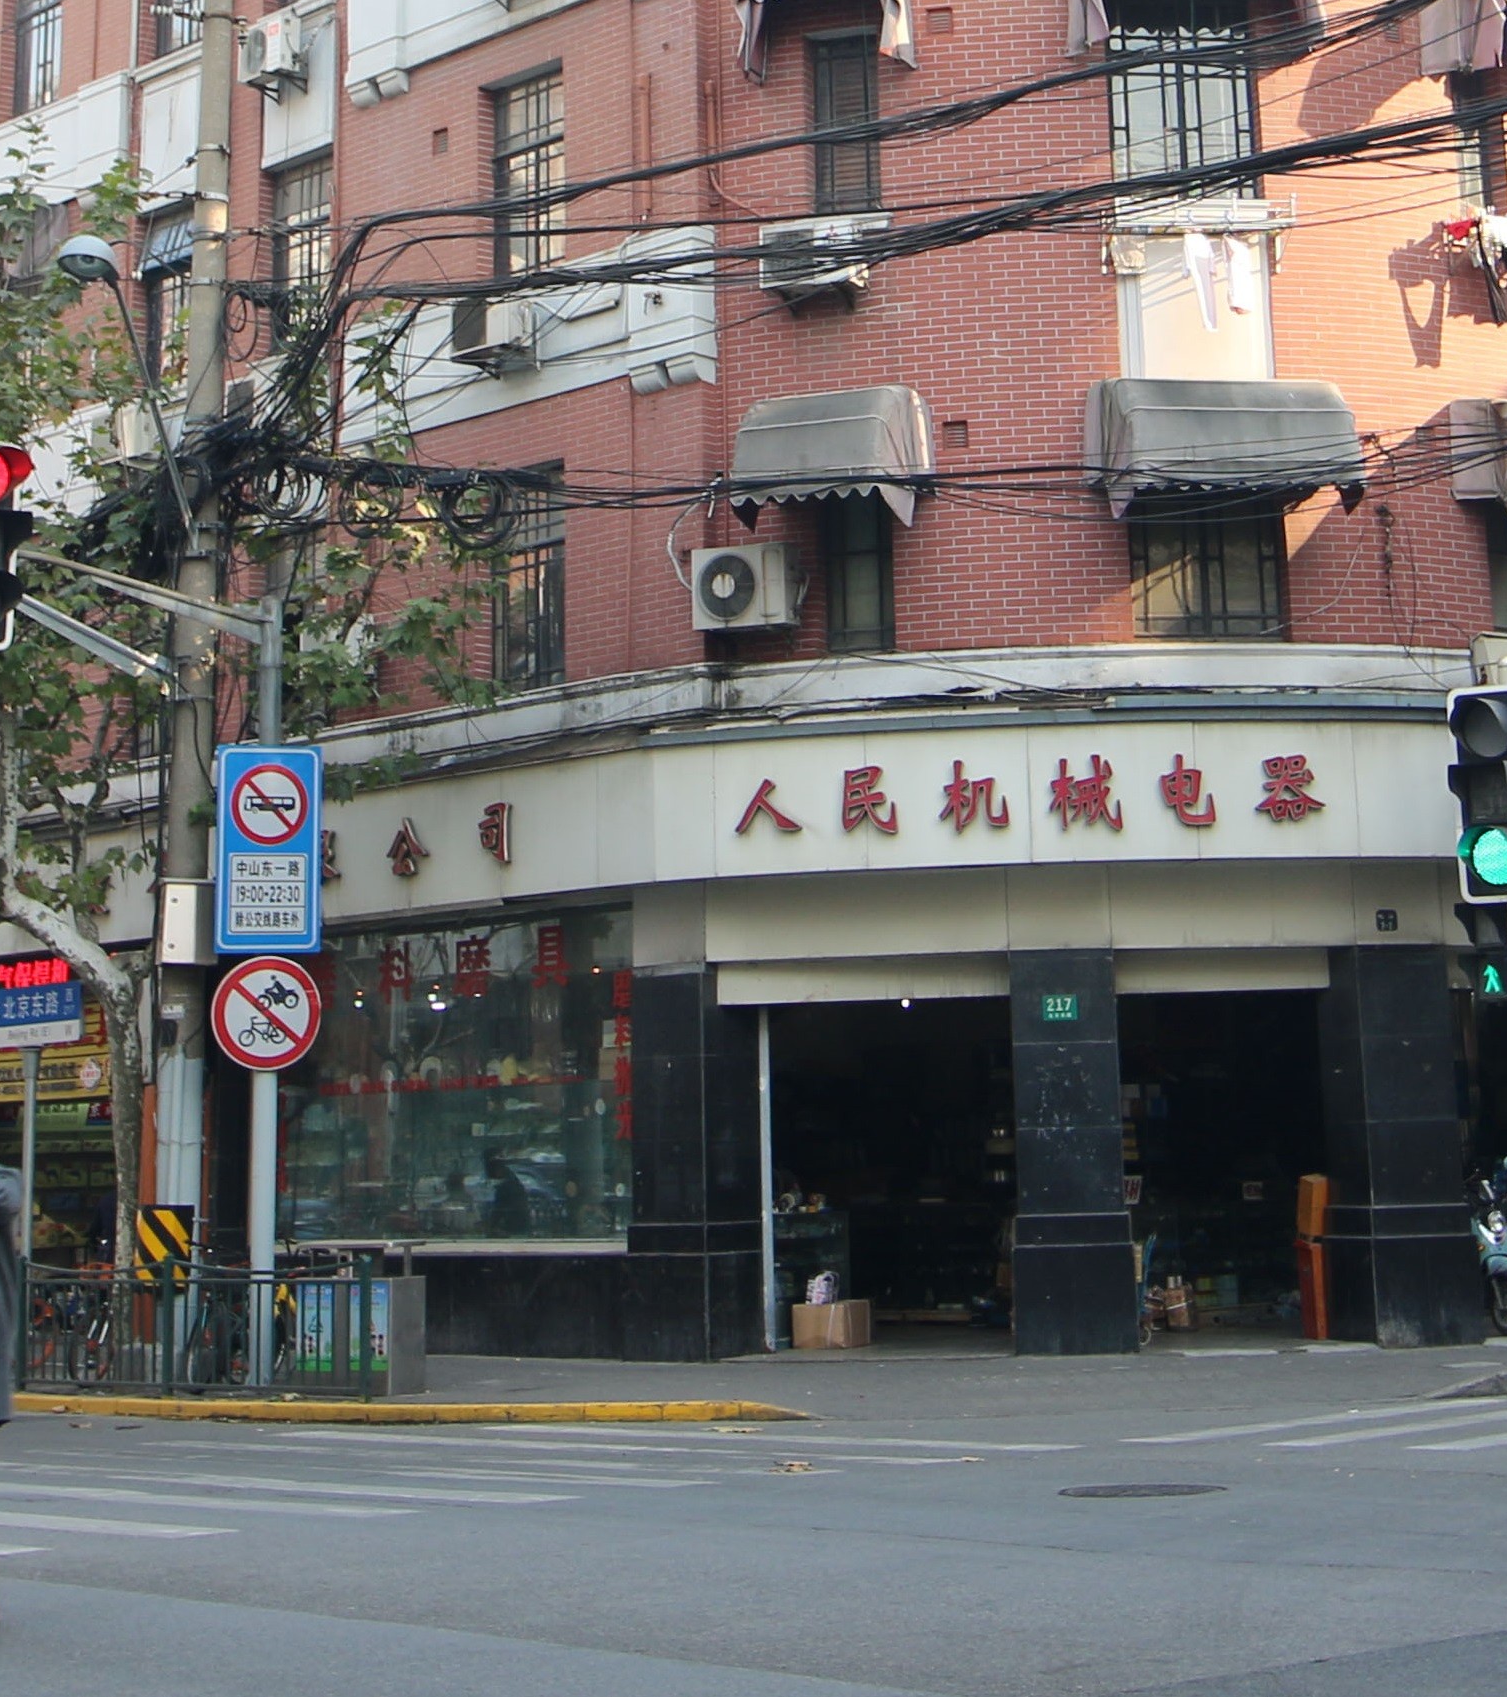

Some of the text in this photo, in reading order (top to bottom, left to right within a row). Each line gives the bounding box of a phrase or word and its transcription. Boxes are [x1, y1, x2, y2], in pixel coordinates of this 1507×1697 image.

[735, 753, 1326, 835] 人民机械电器
[236, 860, 300, 877] 中山东一路
[236, 885, 300, 903] 19:00-22:30
[236, 911, 299, 927] 除公交线路车外
[3, 990, 59, 1019] 北京东路
[1046, 997, 1072, 1012] 217
